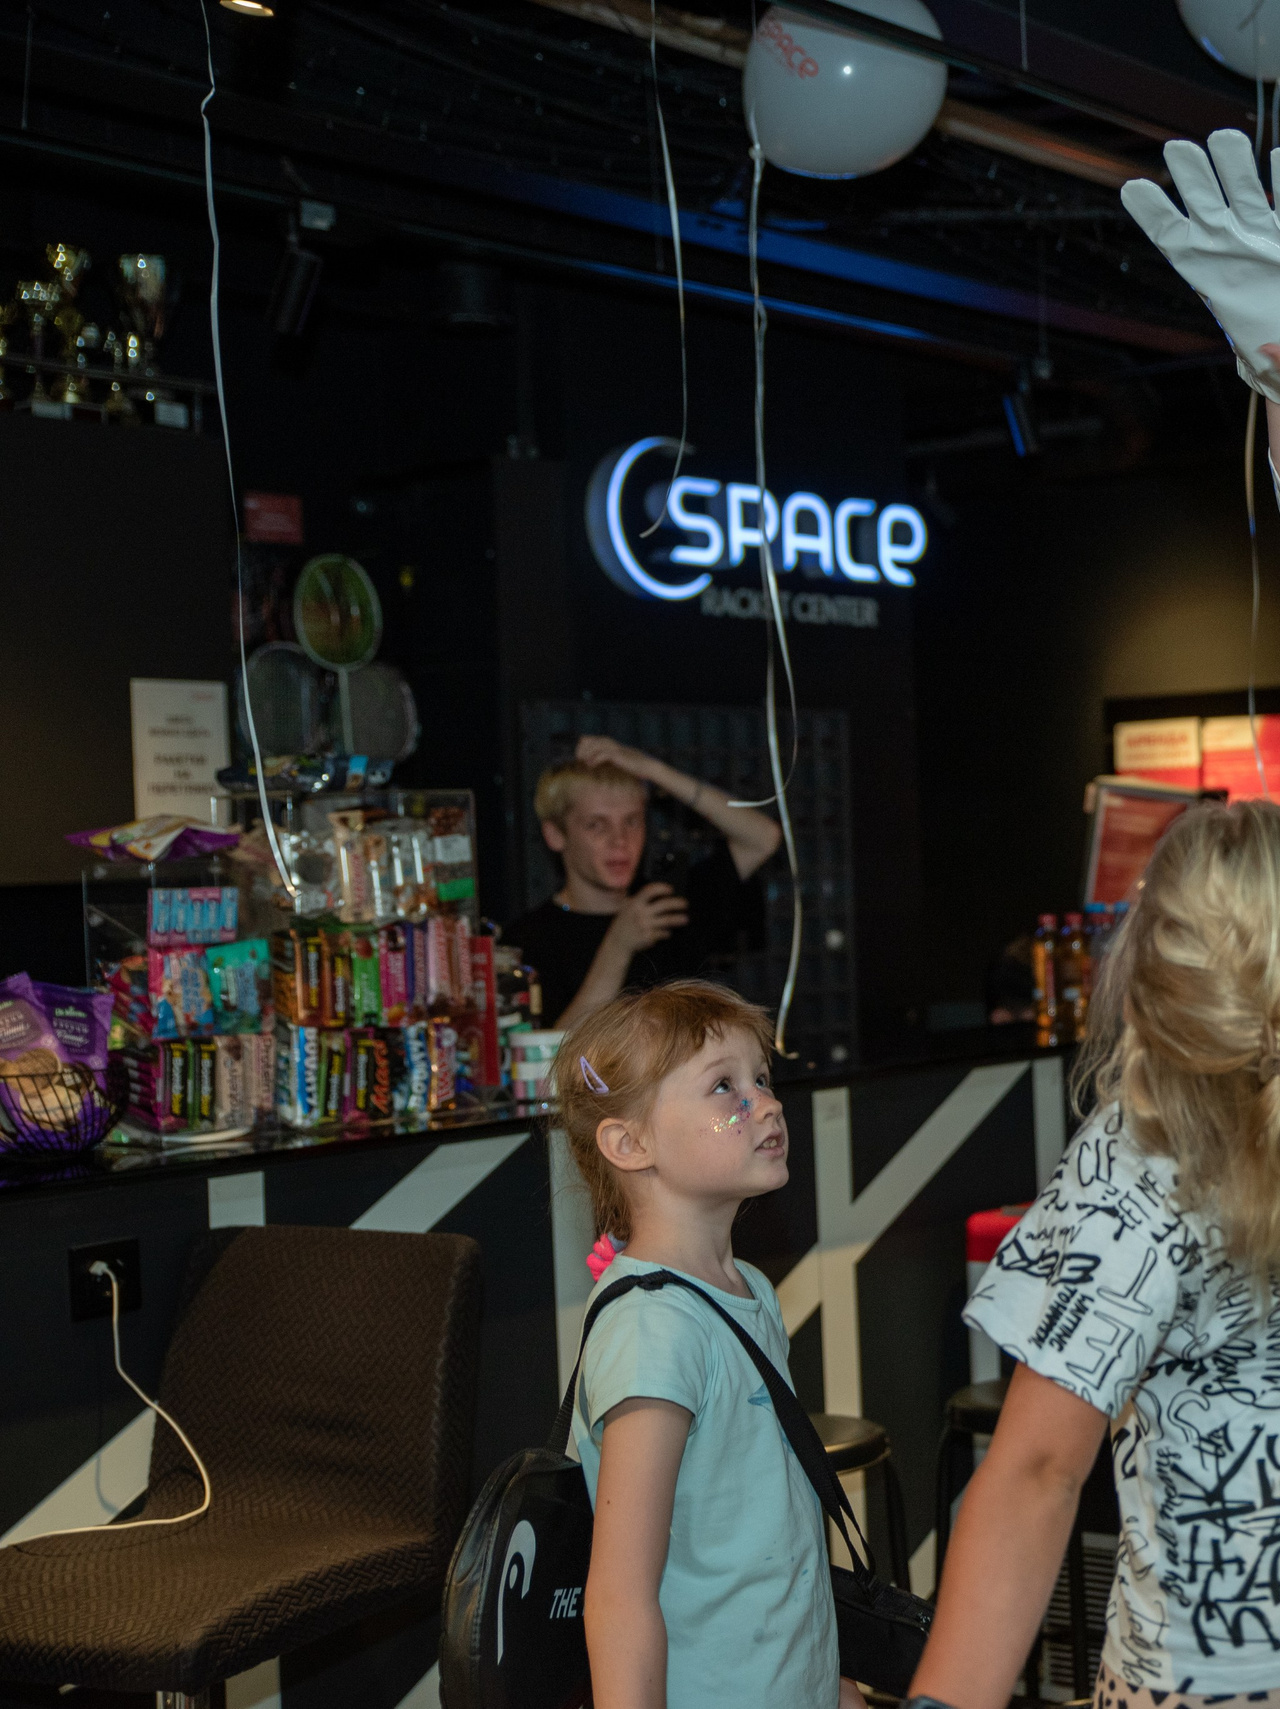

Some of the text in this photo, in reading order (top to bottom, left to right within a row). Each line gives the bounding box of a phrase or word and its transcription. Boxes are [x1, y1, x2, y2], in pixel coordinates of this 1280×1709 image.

[370, 1040, 390, 1114] Mars
[1048, 1293, 1094, 1353] WAITING
[1155, 1526, 1181, 1565] all
[549, 1587, 581, 1620] THE
